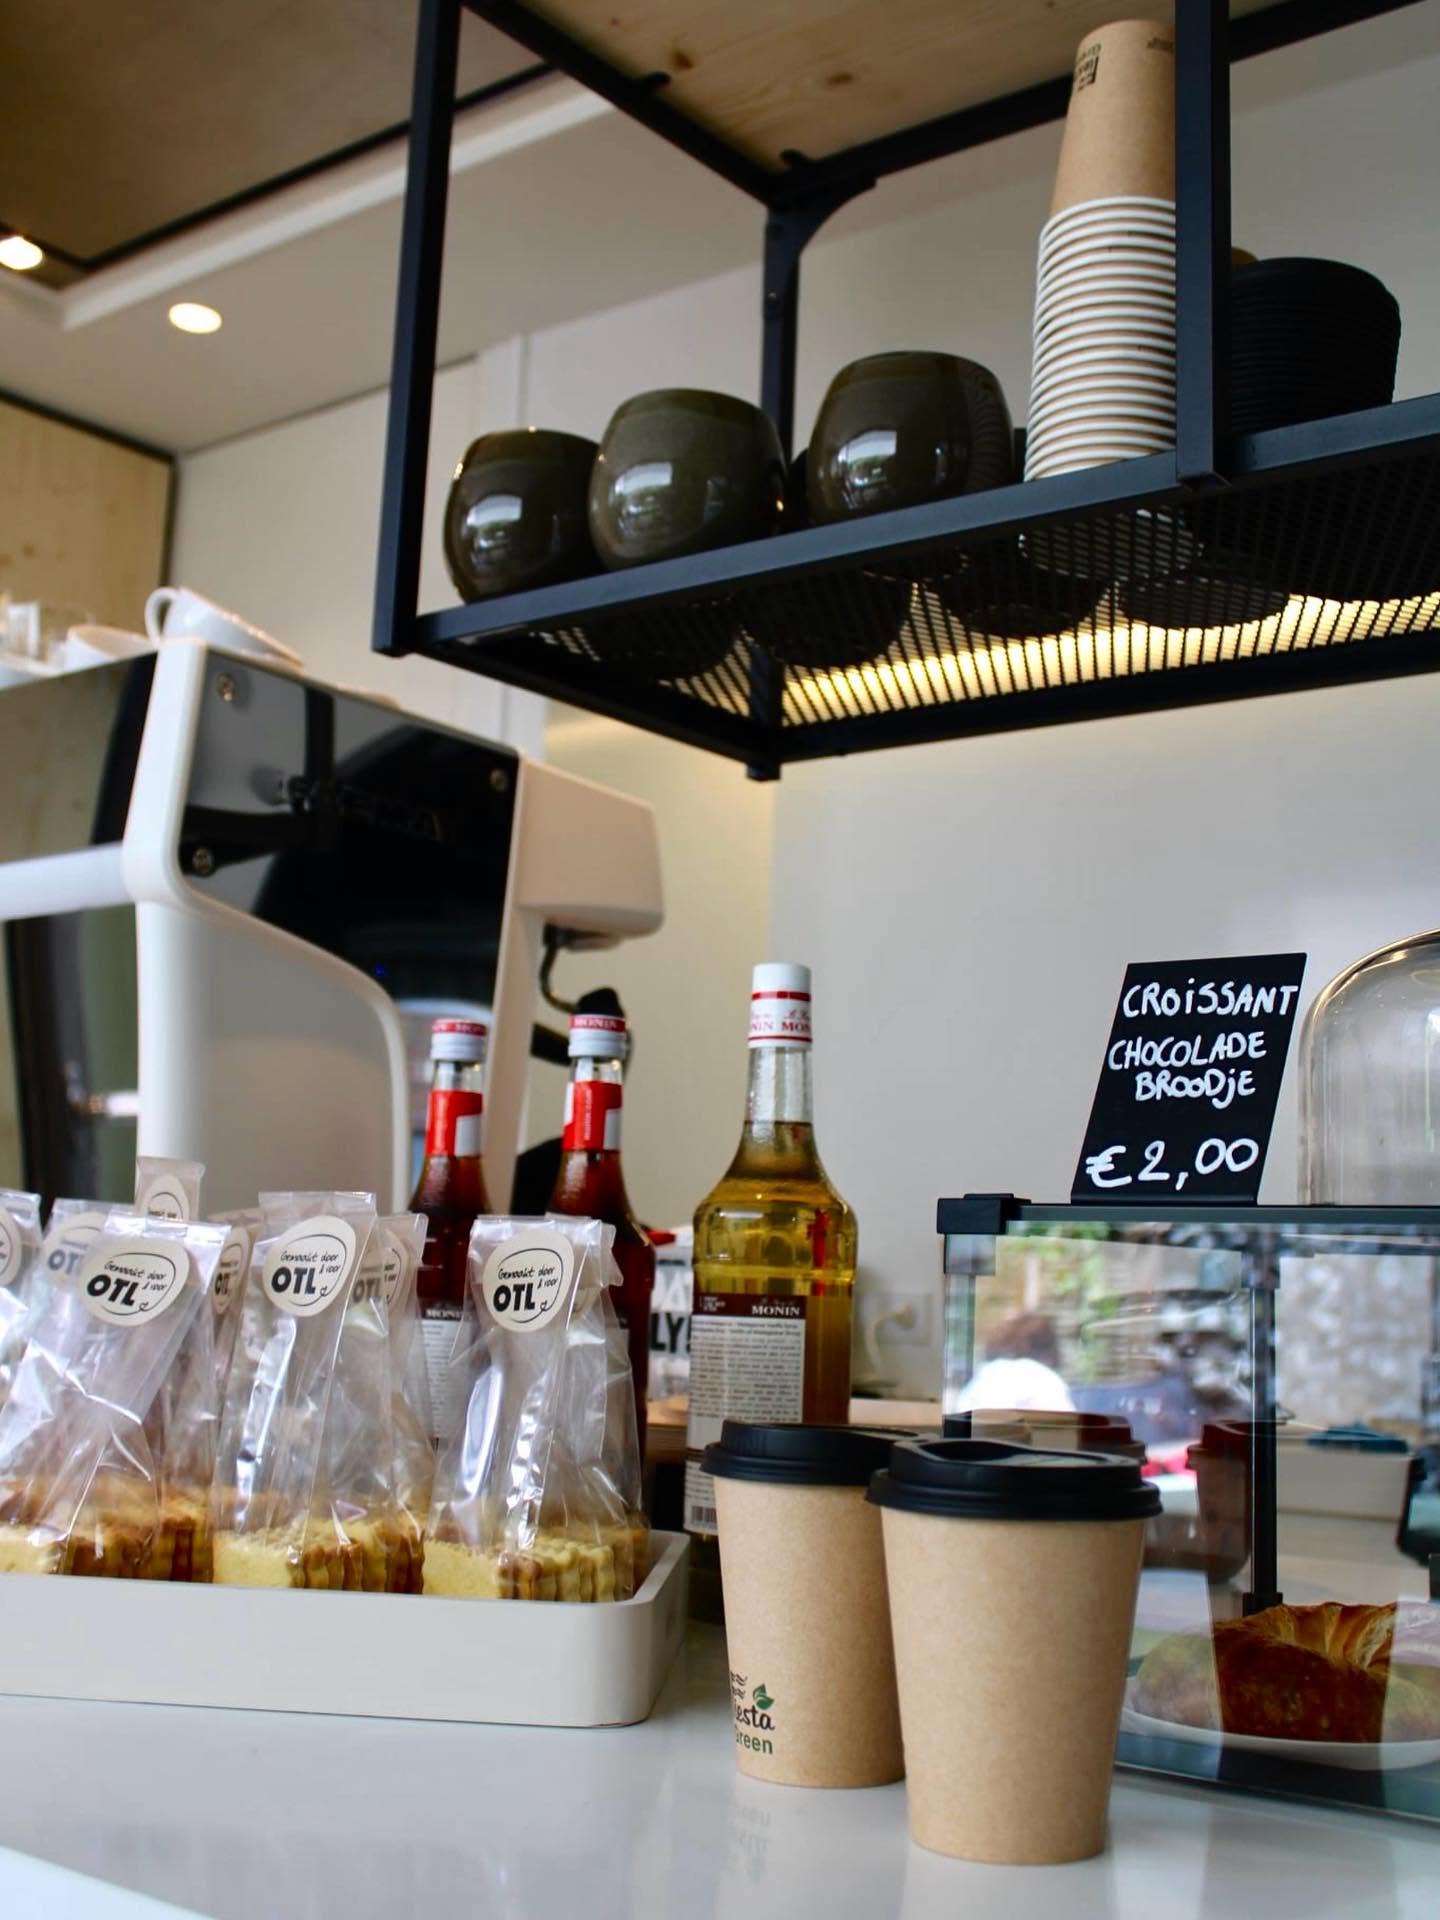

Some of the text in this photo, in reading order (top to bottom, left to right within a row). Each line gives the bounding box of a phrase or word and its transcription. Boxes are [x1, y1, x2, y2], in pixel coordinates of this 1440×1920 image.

[1107, 1031, 1267, 1070] CHOCOLADE
[48, 1248, 84, 1275] OT
[87, 1274, 140, 1307] OTL
[271, 1267, 317, 1295] OTL
[493, 1282, 536, 1313] OTL
[751, 1304, 800, 1317] MONIN
